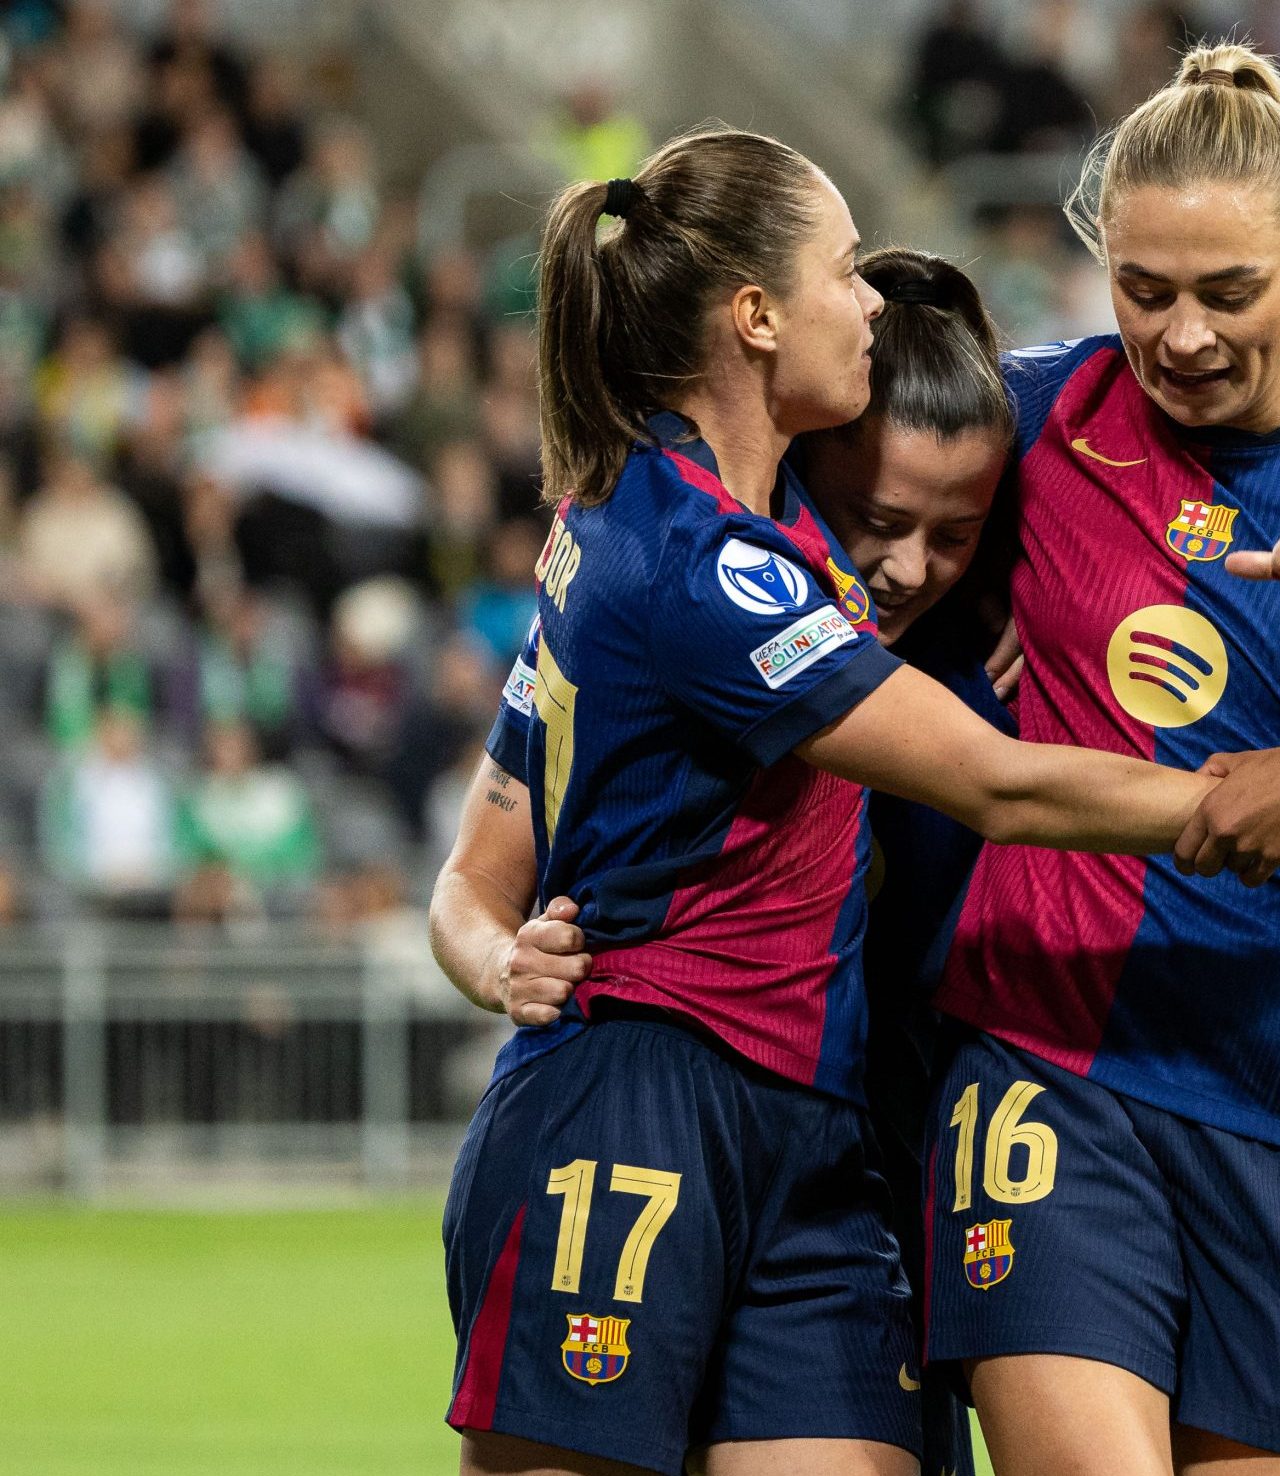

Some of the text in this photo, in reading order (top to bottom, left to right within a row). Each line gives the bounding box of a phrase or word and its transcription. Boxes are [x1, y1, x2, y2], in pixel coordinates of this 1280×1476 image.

[535, 512, 581, 614] JOR
[755, 641, 780, 662] UEFA
[949, 1080, 1059, 1213] 16
[546, 1158, 683, 1304] 17
[582, 1343, 609, 1353] FCB
